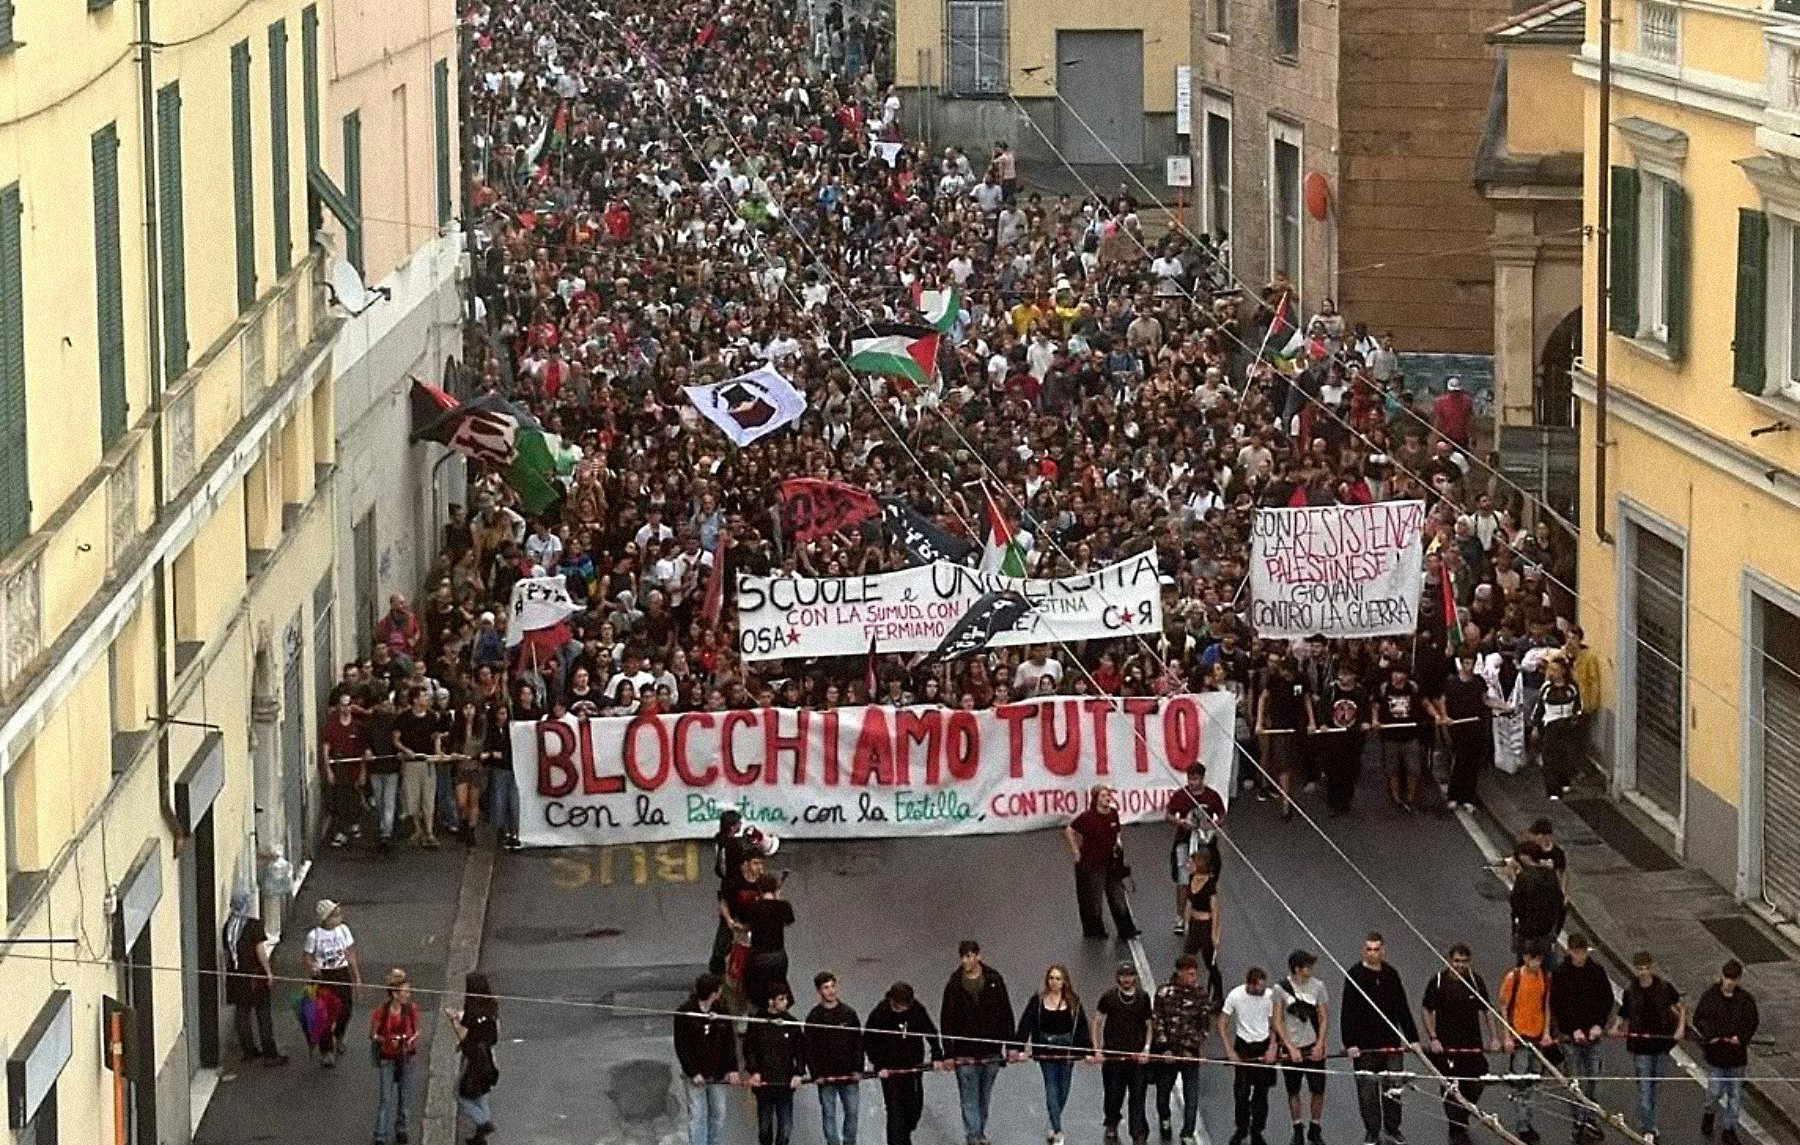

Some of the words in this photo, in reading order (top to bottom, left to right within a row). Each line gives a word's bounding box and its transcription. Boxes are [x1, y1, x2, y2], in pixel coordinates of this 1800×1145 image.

[1254, 509, 1291, 538] CON
[1263, 535, 1294, 557] LA
[1294, 503, 1424, 558] RESISTENZA
[1265, 551, 1388, 584] PALESTINESE
[738, 576, 883, 612] SCUOLE
[900, 587, 918, 602] e
[1290, 581, 1364, 604] GIOVANI
[786, 609, 829, 627] CON
[837, 606, 862, 625] LA
[927, 601, 959, 620] CON
[1253, 600, 1313, 630] CONTRO
[1321, 600, 1344, 630] LA
[1348, 597, 1412, 629] GUERRA
[740, 625, 787, 654] OSA
[864, 621, 945, 641] FERMIAMO
[536, 705, 981, 797] BLOCCHIAMO
[995, 698, 1200, 778] TUTTO
[632, 794, 671, 826] la
[803, 804, 847, 824] con
[857, 792, 889, 822] la
[991, 789, 1078, 817] CONTRO
